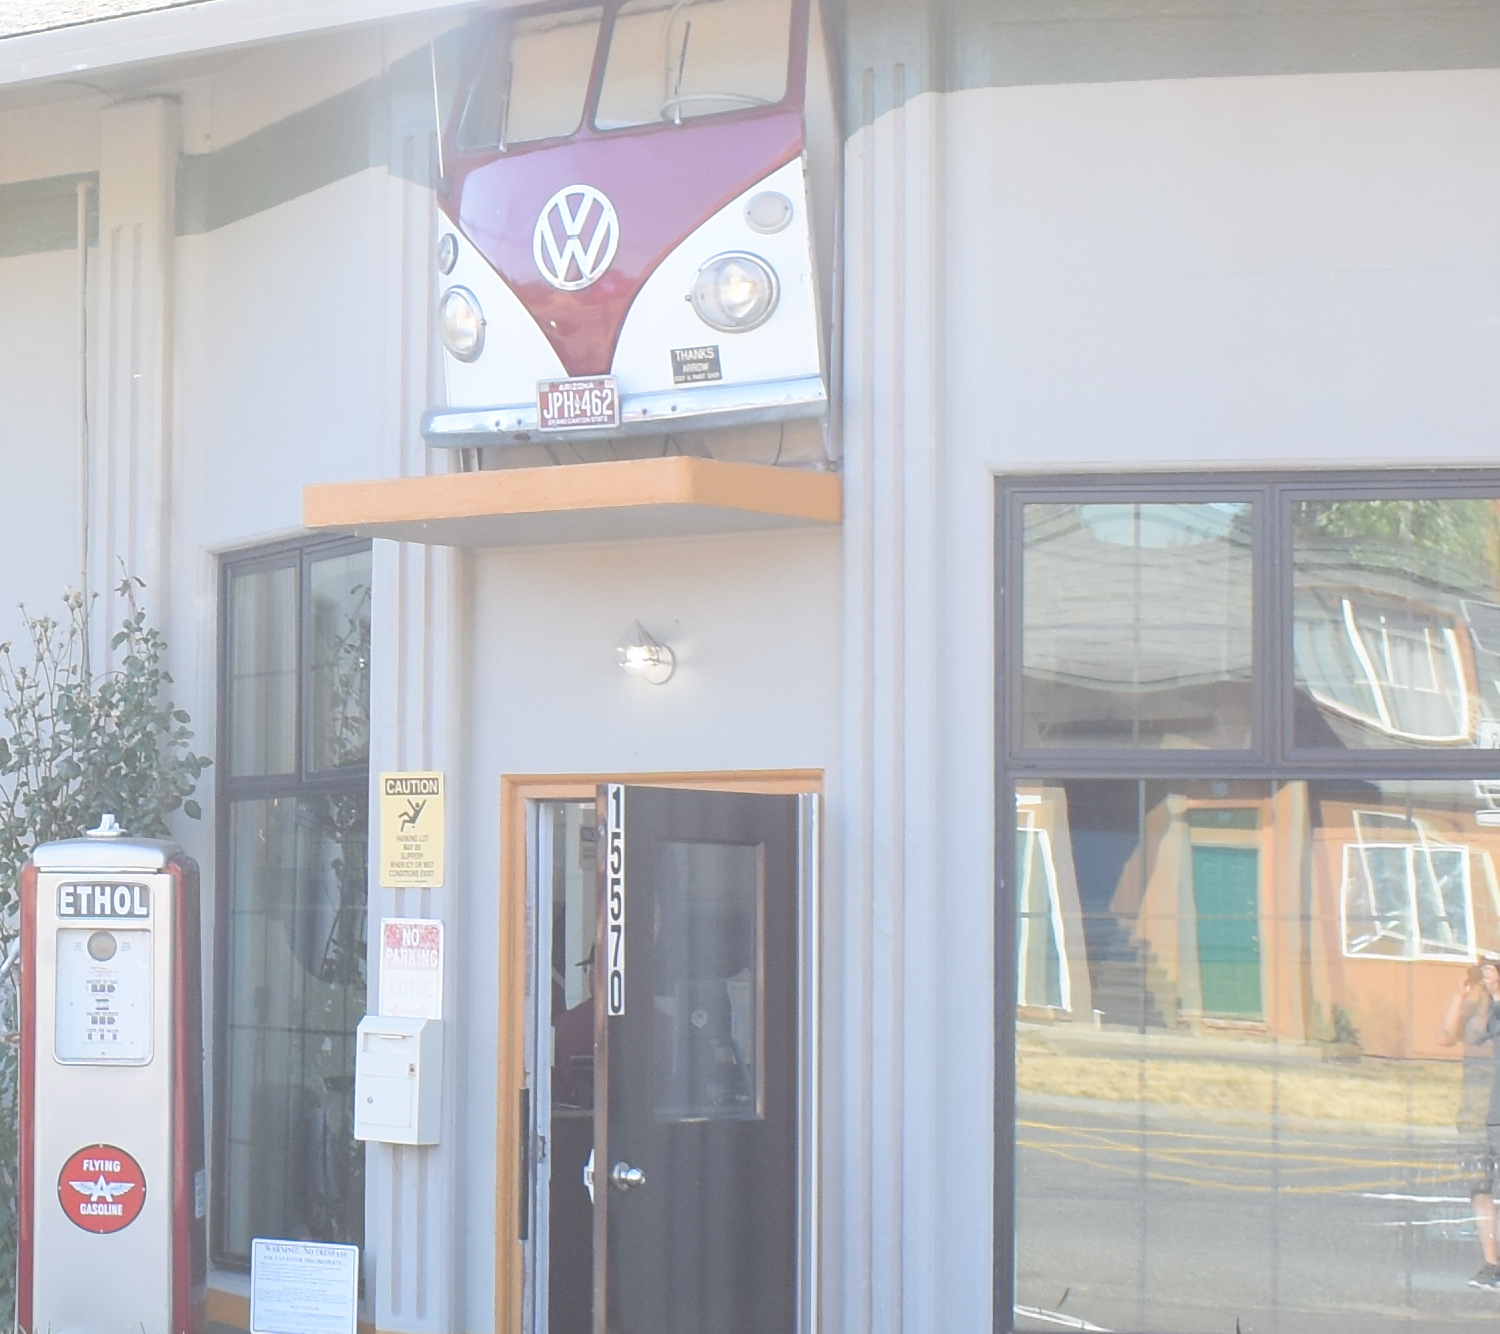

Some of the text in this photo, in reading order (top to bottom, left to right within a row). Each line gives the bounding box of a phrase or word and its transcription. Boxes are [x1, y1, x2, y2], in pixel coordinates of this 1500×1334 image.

[675, 347, 714, 361] THANKS
[558, 382, 594, 390] ARIZONA
[543, 389, 613, 419] JPH 462
[386, 779, 438, 794] CAUTION
[60, 886, 147, 915] ETHOL
[610, 786, 622, 1014] 15570
[402, 928, 419, 946] NO
[385, 948, 438, 967] PARKING
[83, 1159, 121, 1172] FLYING
[80, 1203, 123, 1216] GASOLINE
